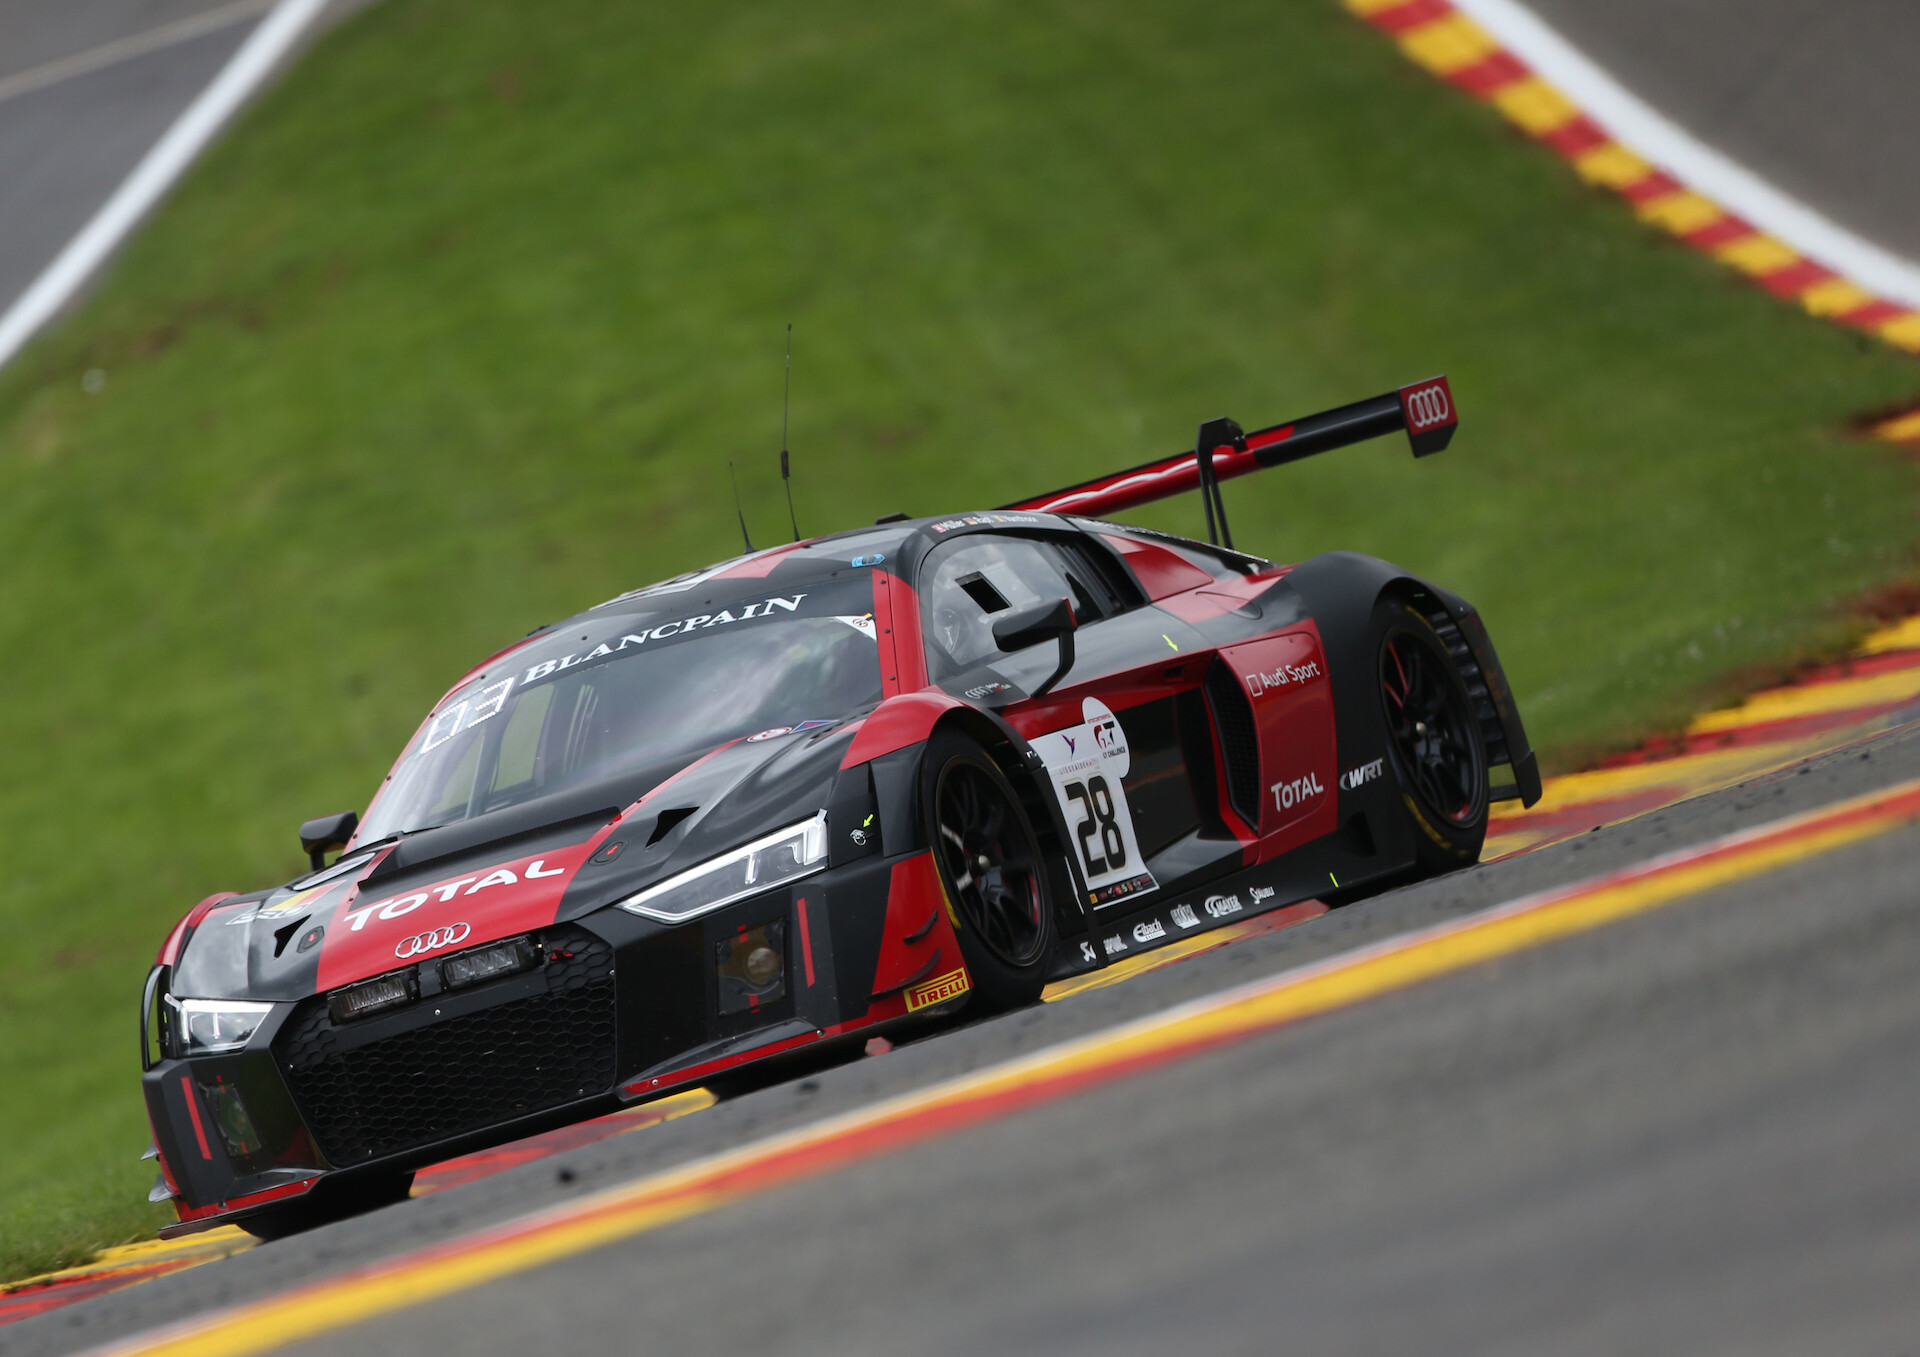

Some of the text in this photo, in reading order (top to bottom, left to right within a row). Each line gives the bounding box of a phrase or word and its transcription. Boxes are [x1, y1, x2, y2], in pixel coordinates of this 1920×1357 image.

[519, 594, 807, 686] BLANCPAIN
[1260, 661, 1320, 688] Audi Sport
[1271, 772, 1324, 812] TOTAL
[1348, 758, 1383, 789] WRT
[1063, 775, 1126, 879] 28
[344, 860, 564, 931] TOTAL
[1133, 919, 1164, 942] Eibach
[910, 972, 967, 1009] PIRELLI
